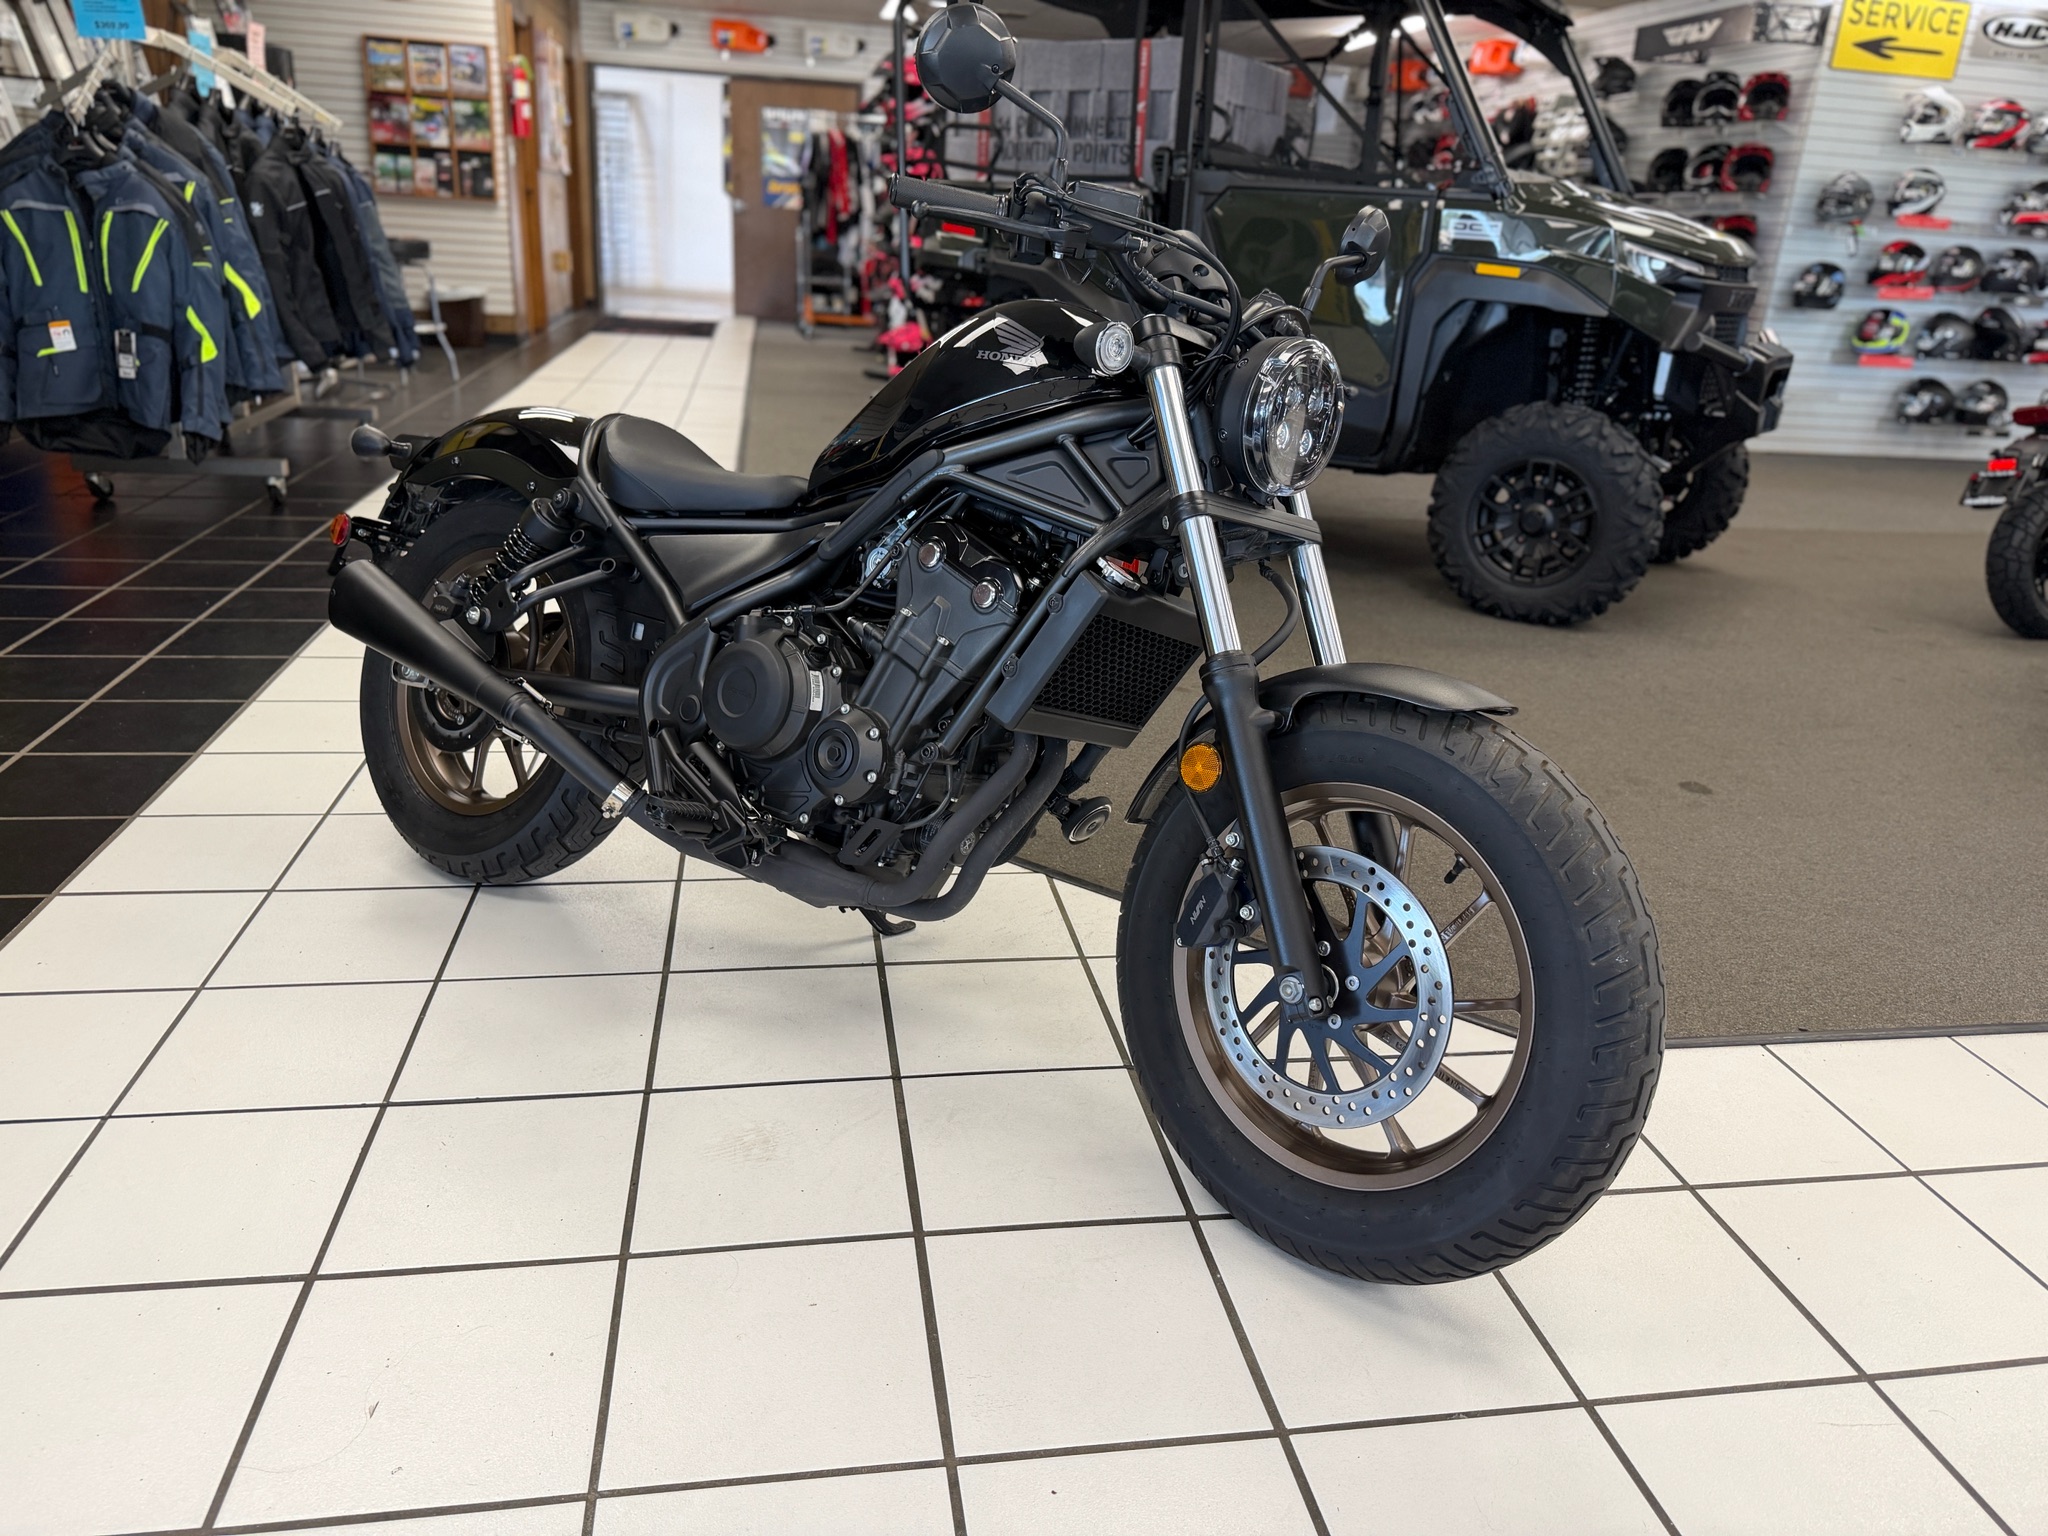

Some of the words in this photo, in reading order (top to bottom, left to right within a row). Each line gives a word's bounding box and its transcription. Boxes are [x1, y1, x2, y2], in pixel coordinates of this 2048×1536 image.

[1849, 0, 1964, 36] SERVICE
[1663, 17, 1723, 47] FLY
[1993, 21, 2048, 41] HJC
[993, 140, 1058, 161] OUNTIN
[1072, 144, 1131, 165] POINTS
[976, 350, 1034, 367] HONDA
